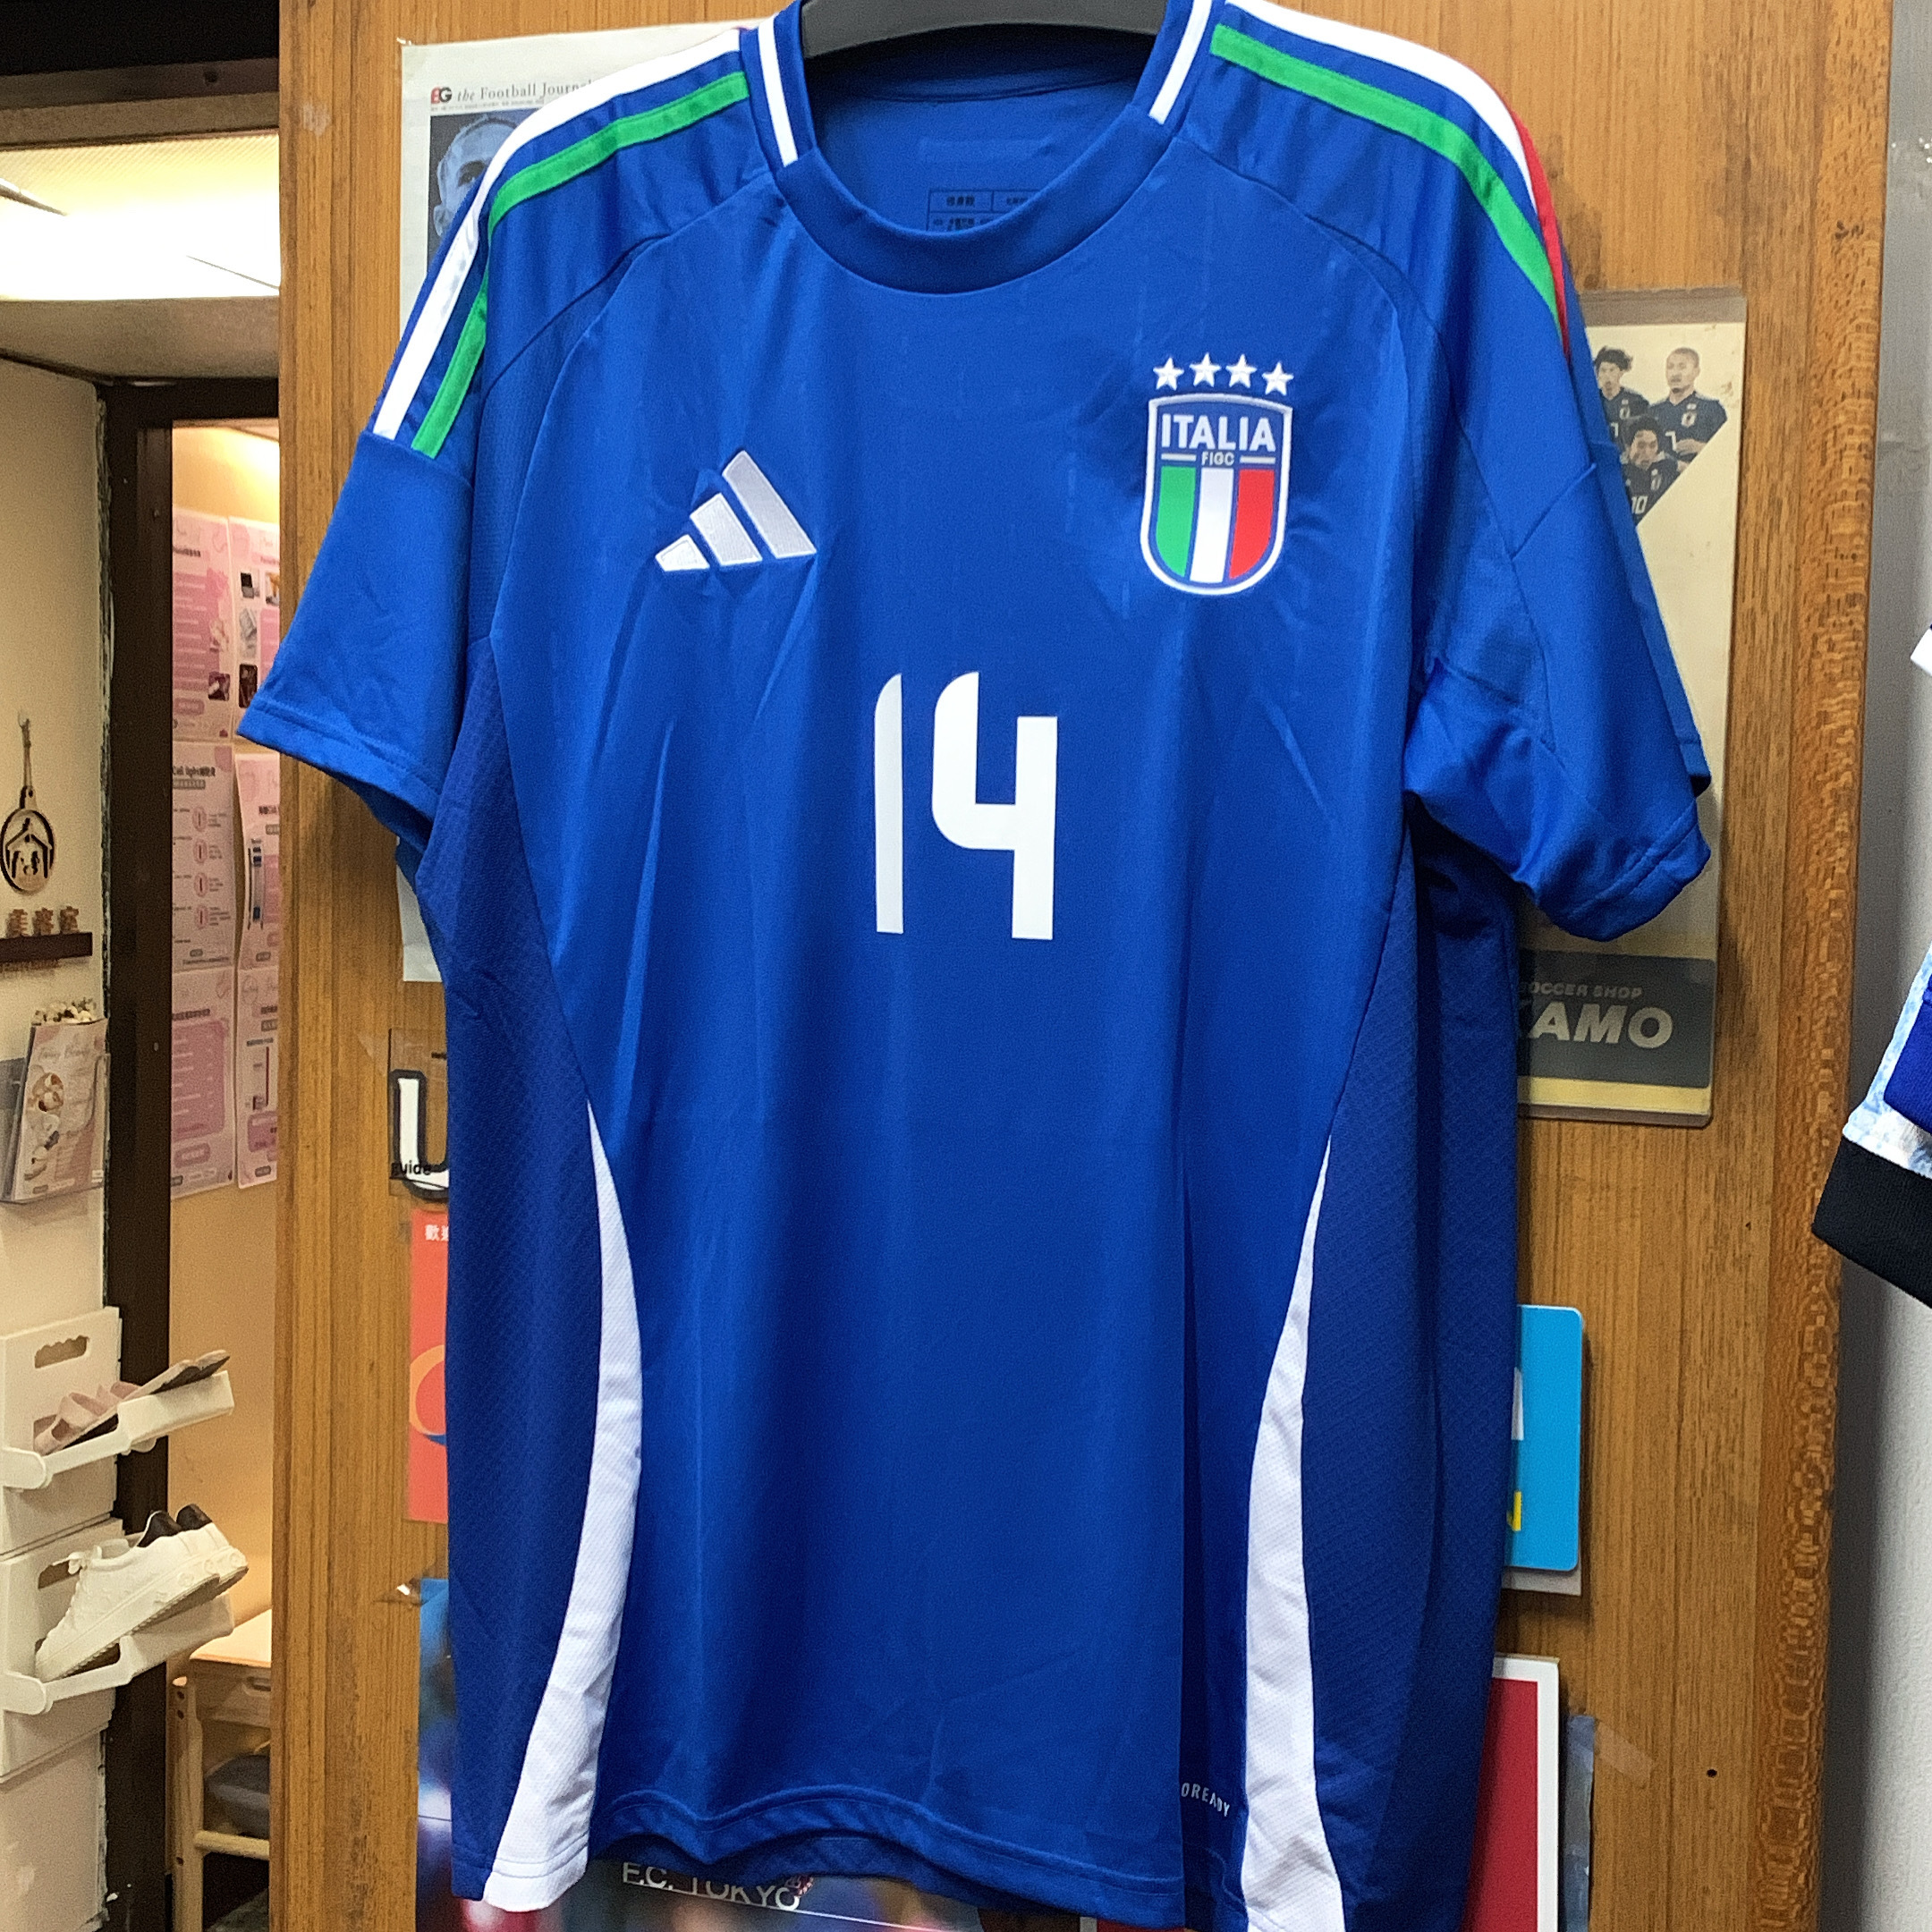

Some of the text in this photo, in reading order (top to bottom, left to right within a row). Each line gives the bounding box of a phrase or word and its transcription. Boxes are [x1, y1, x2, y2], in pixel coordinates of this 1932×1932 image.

[457, 87, 476, 102] the
[480, 83, 537, 100] Football
[542, 79, 592, 98] Journ
[1161, 413, 1276, 452] ITALIA
[1201, 451, 1235, 466] FIGC
[1631, 496, 1648, 515] 10
[874, 671, 1058, 940] 14
[1528, 981, 1643, 999] OCCER SHOP
[1528, 1001, 1674, 1049] AMO
[1181, 1782, 1231, 1818] OREADY
